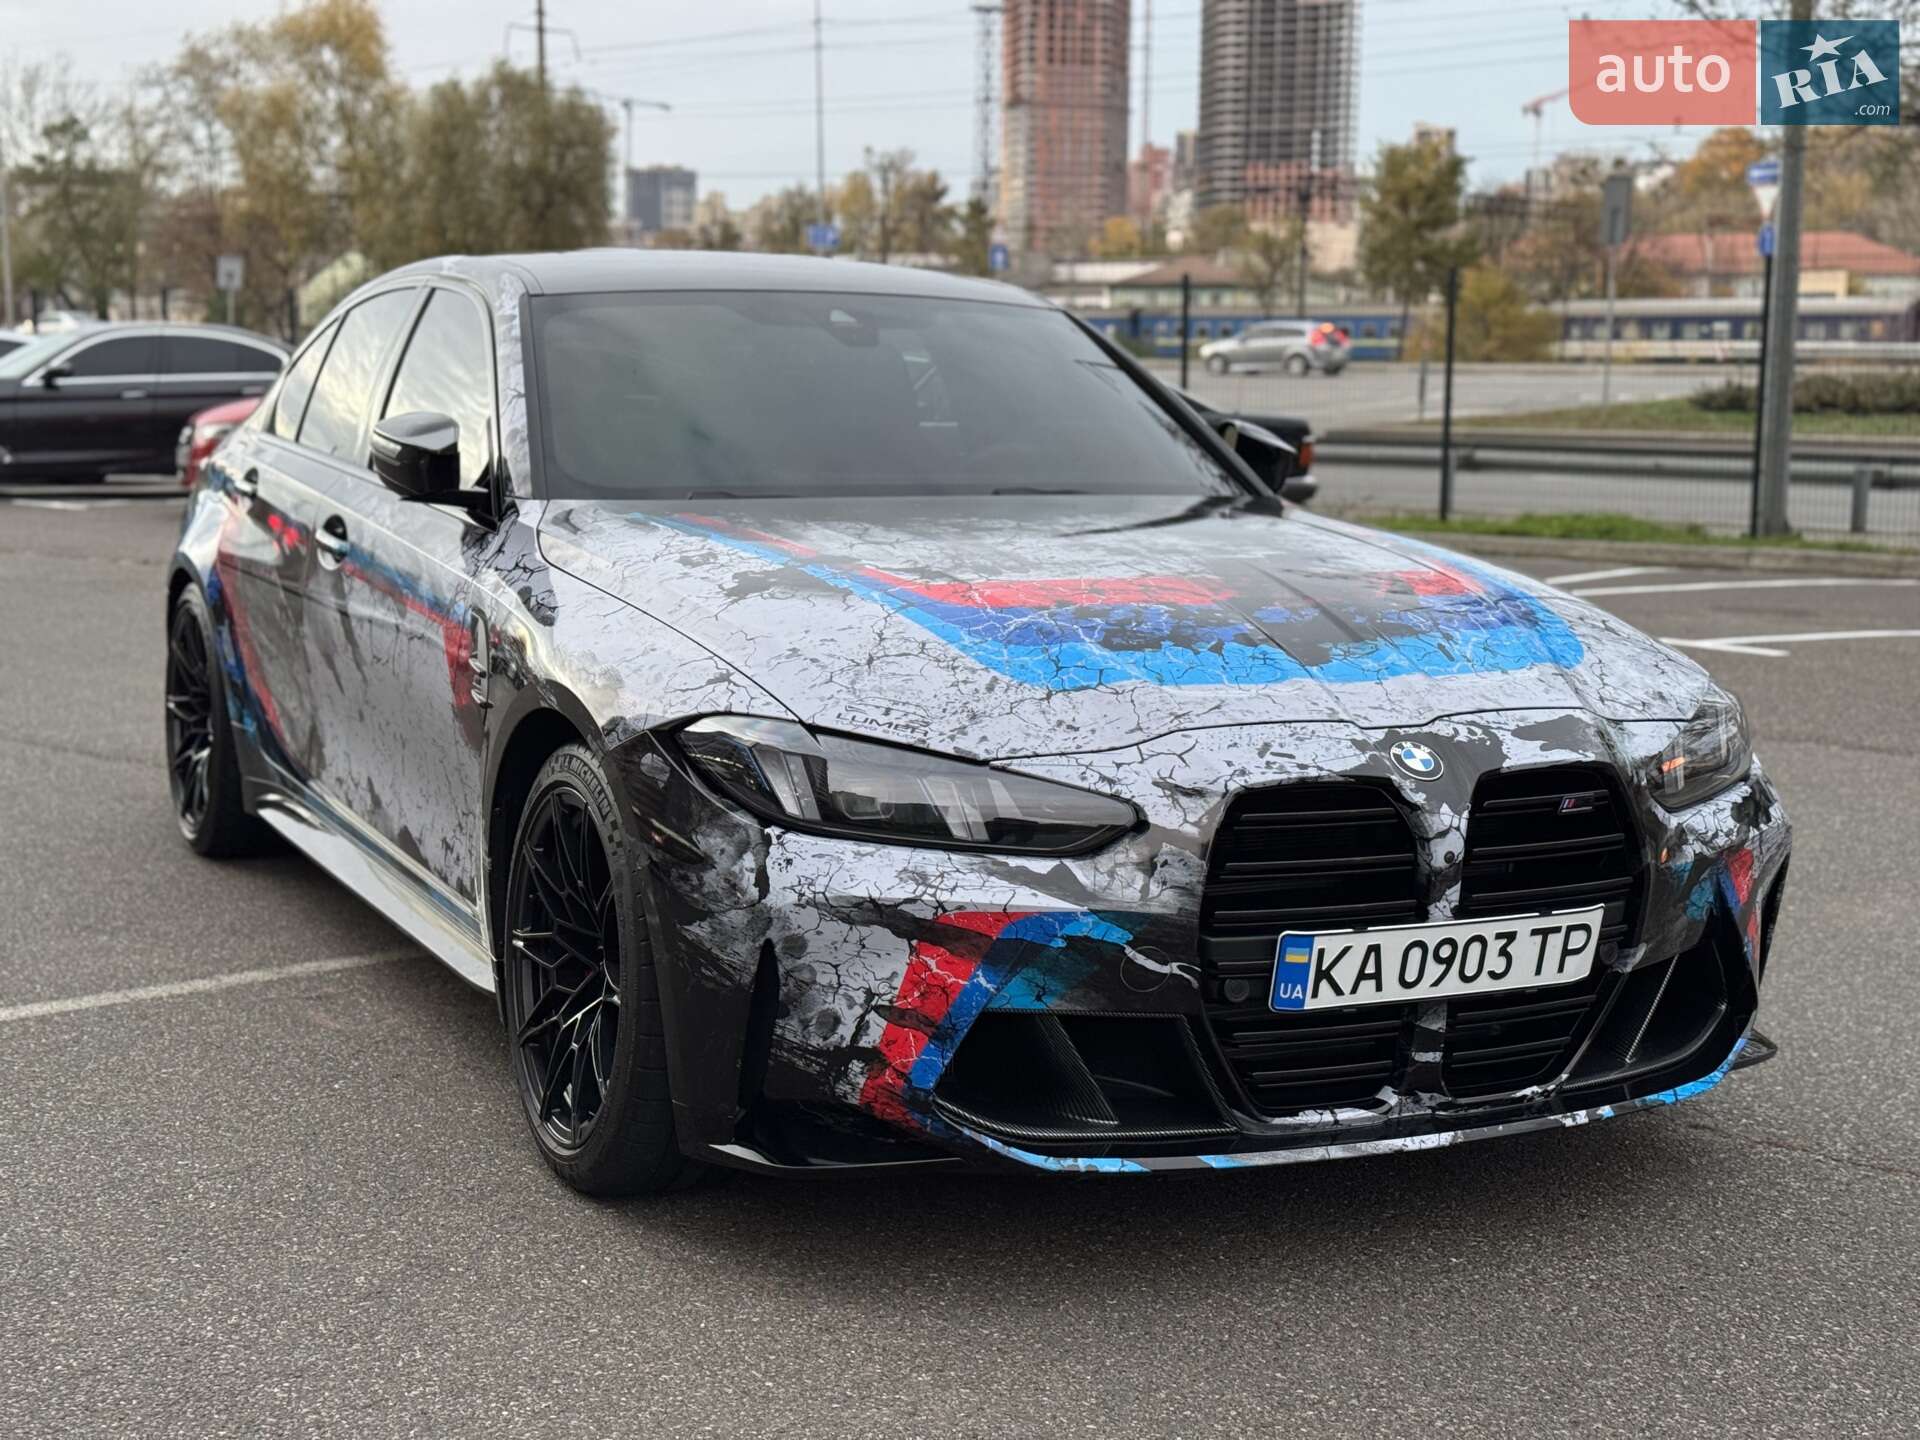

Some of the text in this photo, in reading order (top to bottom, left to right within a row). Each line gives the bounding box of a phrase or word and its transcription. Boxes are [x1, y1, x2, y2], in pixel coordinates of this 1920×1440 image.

[570, 757, 612, 819] MICHELIN
[1280, 983, 1303, 1000] UA
[1310, 922, 1593, 999] KA 0903 TP
